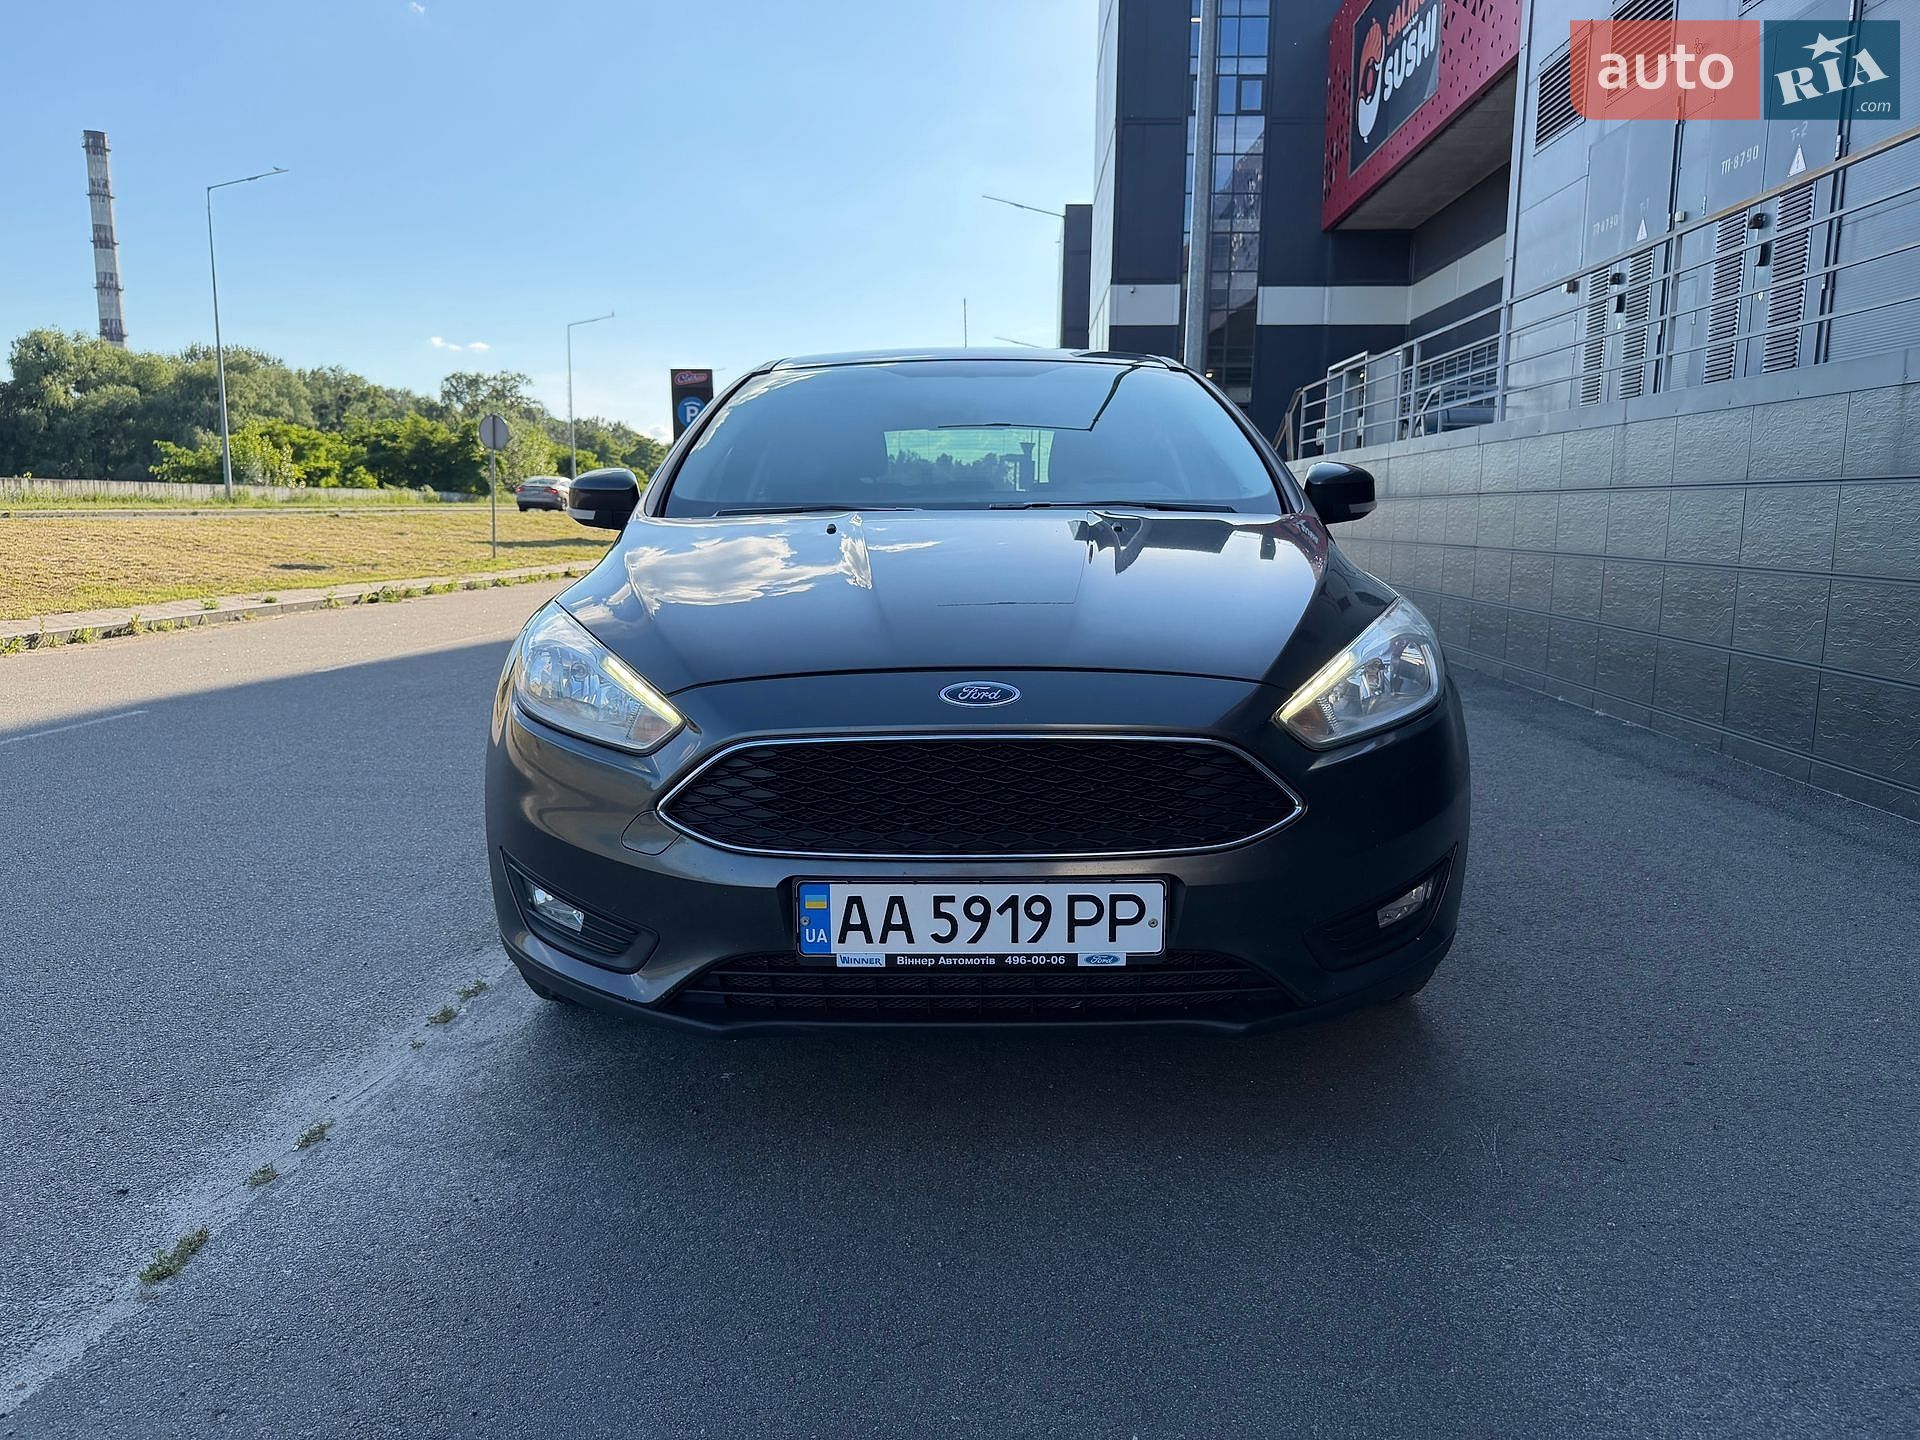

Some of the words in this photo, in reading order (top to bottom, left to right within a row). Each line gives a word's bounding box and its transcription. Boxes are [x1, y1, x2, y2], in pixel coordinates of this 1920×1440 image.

[1383, 4, 1437, 102] SUSHI
[958, 686, 1001, 700] Ford
[837, 894, 915, 944] AA
[930, 893, 1052, 944] 5919
[1066, 893, 1146, 944] PP
[805, 927, 828, 943] UA
[896, 955, 935, 967] Віннер
[938, 955, 996, 966] Автомотів
[1005, 955, 1066, 966] 496-00-06
[1090, 955, 1114, 965] Ford
